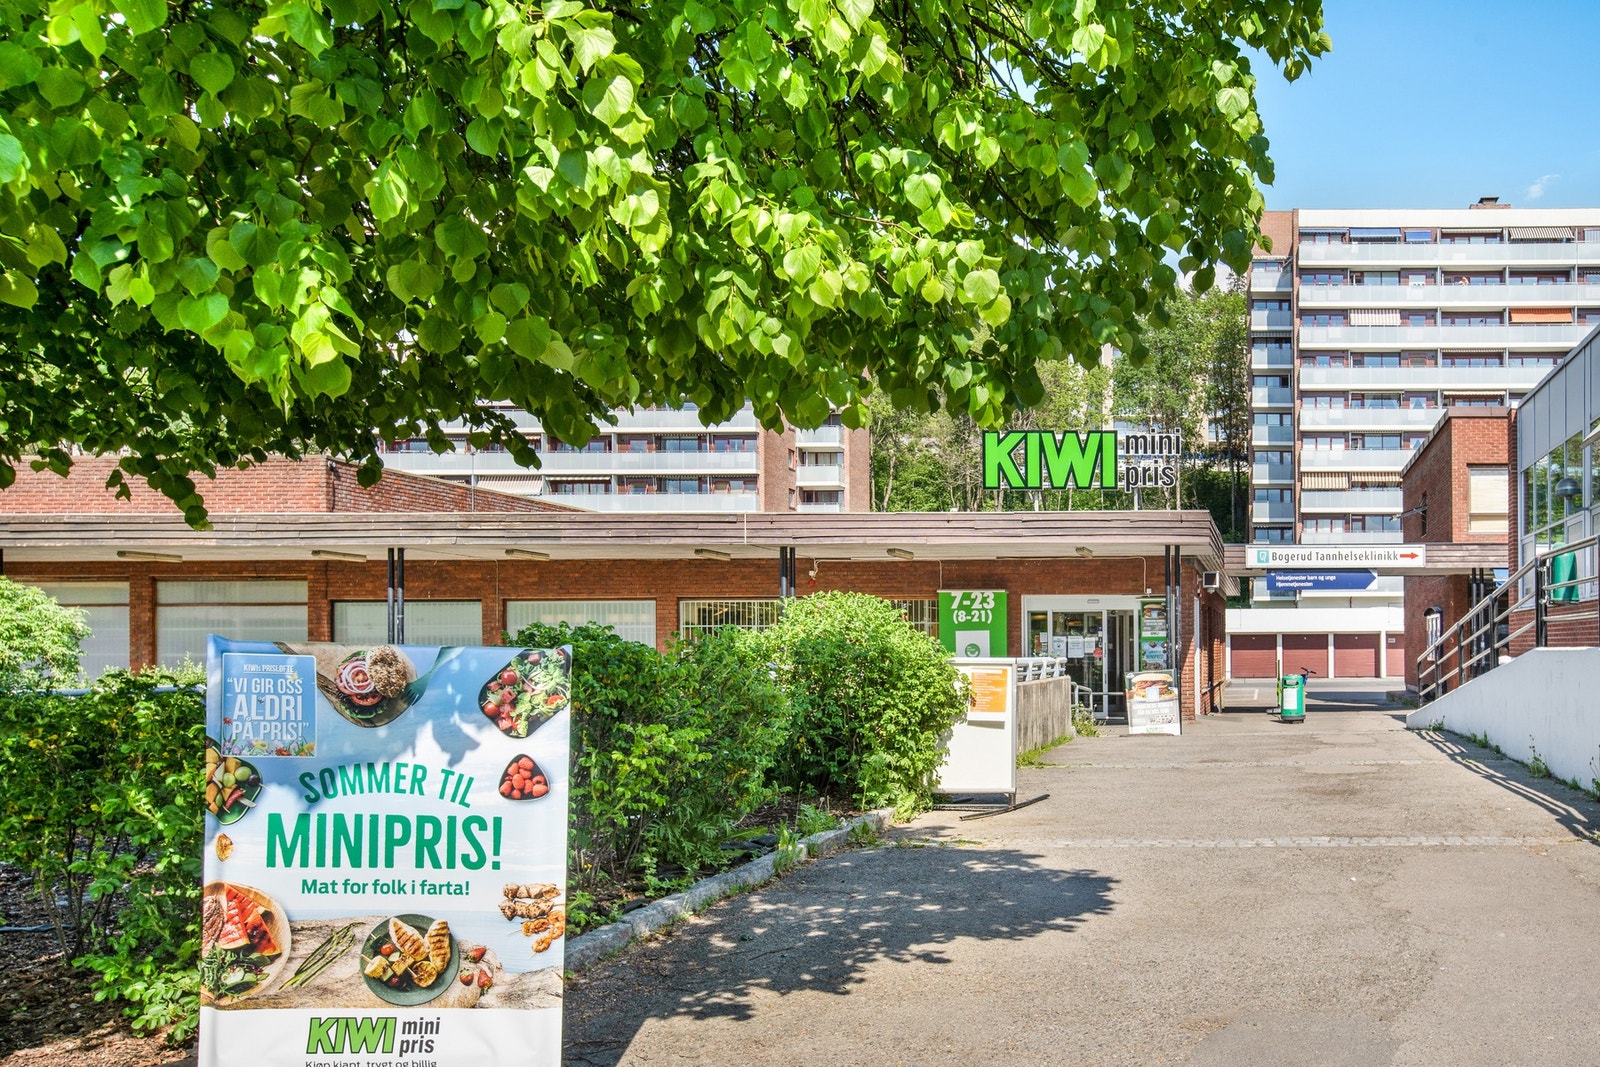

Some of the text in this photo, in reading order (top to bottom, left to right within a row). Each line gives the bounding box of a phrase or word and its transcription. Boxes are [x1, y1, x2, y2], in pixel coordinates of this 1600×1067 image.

[983, 428, 1181, 489] KIWI mini
[1125, 460, 1176, 492] pris
[1271, 550, 1399, 563] Bogerud Tannhelseklinikk
[951, 591, 995, 609] 7-23
[953, 610, 993, 624] (8-21)
[251, 678, 274, 694] GIR
[277, 679, 303, 694] OSS
[232, 694, 302, 721] ALDRI
[232, 716, 254, 740] PÅ
[299, 762, 475, 808] SOMMER TIL
[266, 813, 502, 870] MINIPRIS!
[301, 878, 470, 896] Mat for folk i farta!
[306, 1016, 441, 1054] KIWI mini
[399, 1036, 435, 1057] pris
